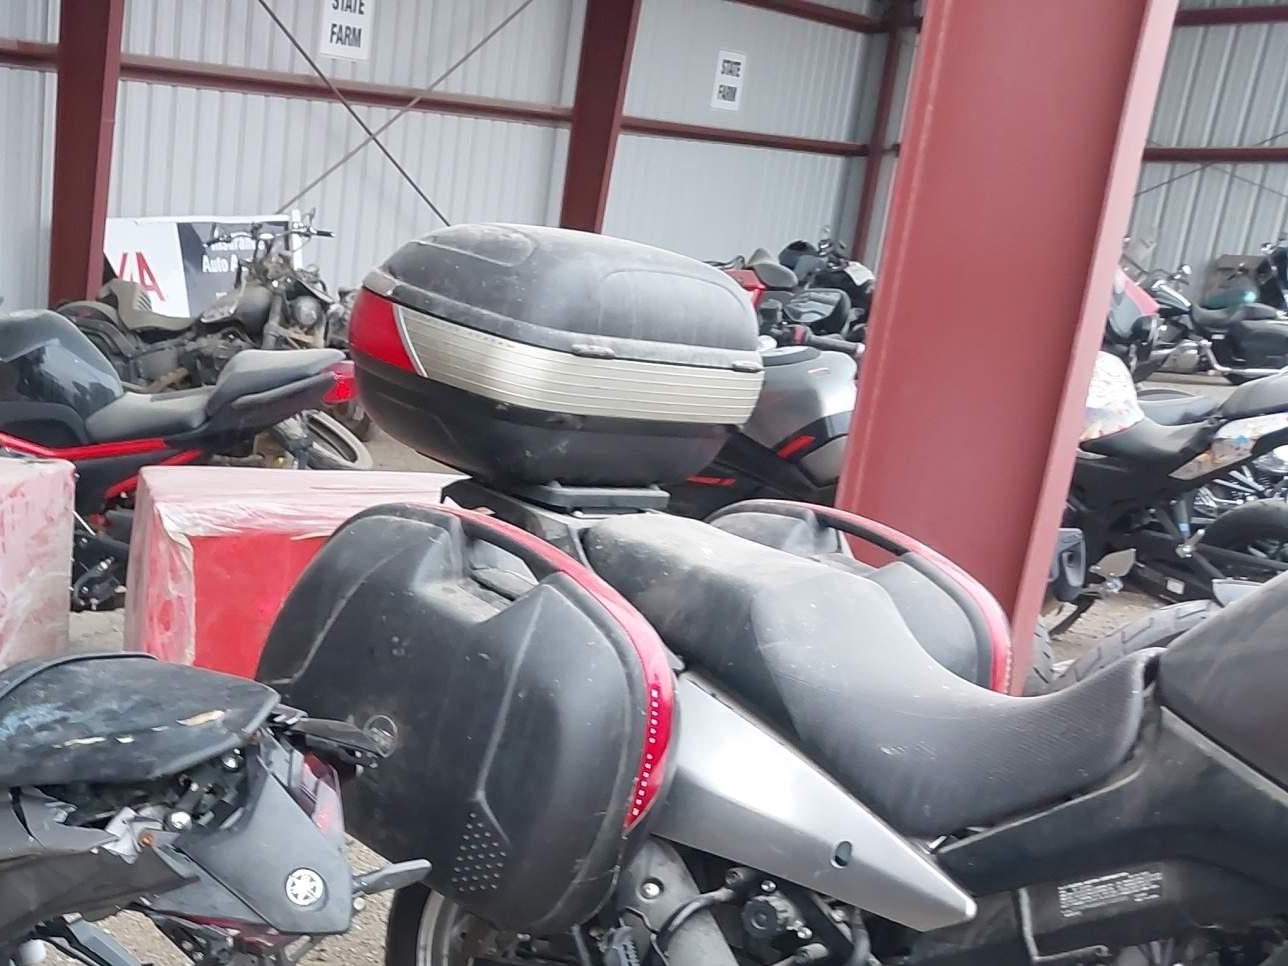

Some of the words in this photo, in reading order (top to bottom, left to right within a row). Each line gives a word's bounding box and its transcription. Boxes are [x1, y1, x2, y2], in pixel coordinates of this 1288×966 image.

[329, 23, 362, 48] FARM
[721, 59, 742, 77] STATE
[717, 84, 738, 102] FARM
[202, 253, 229, 273] Auto
